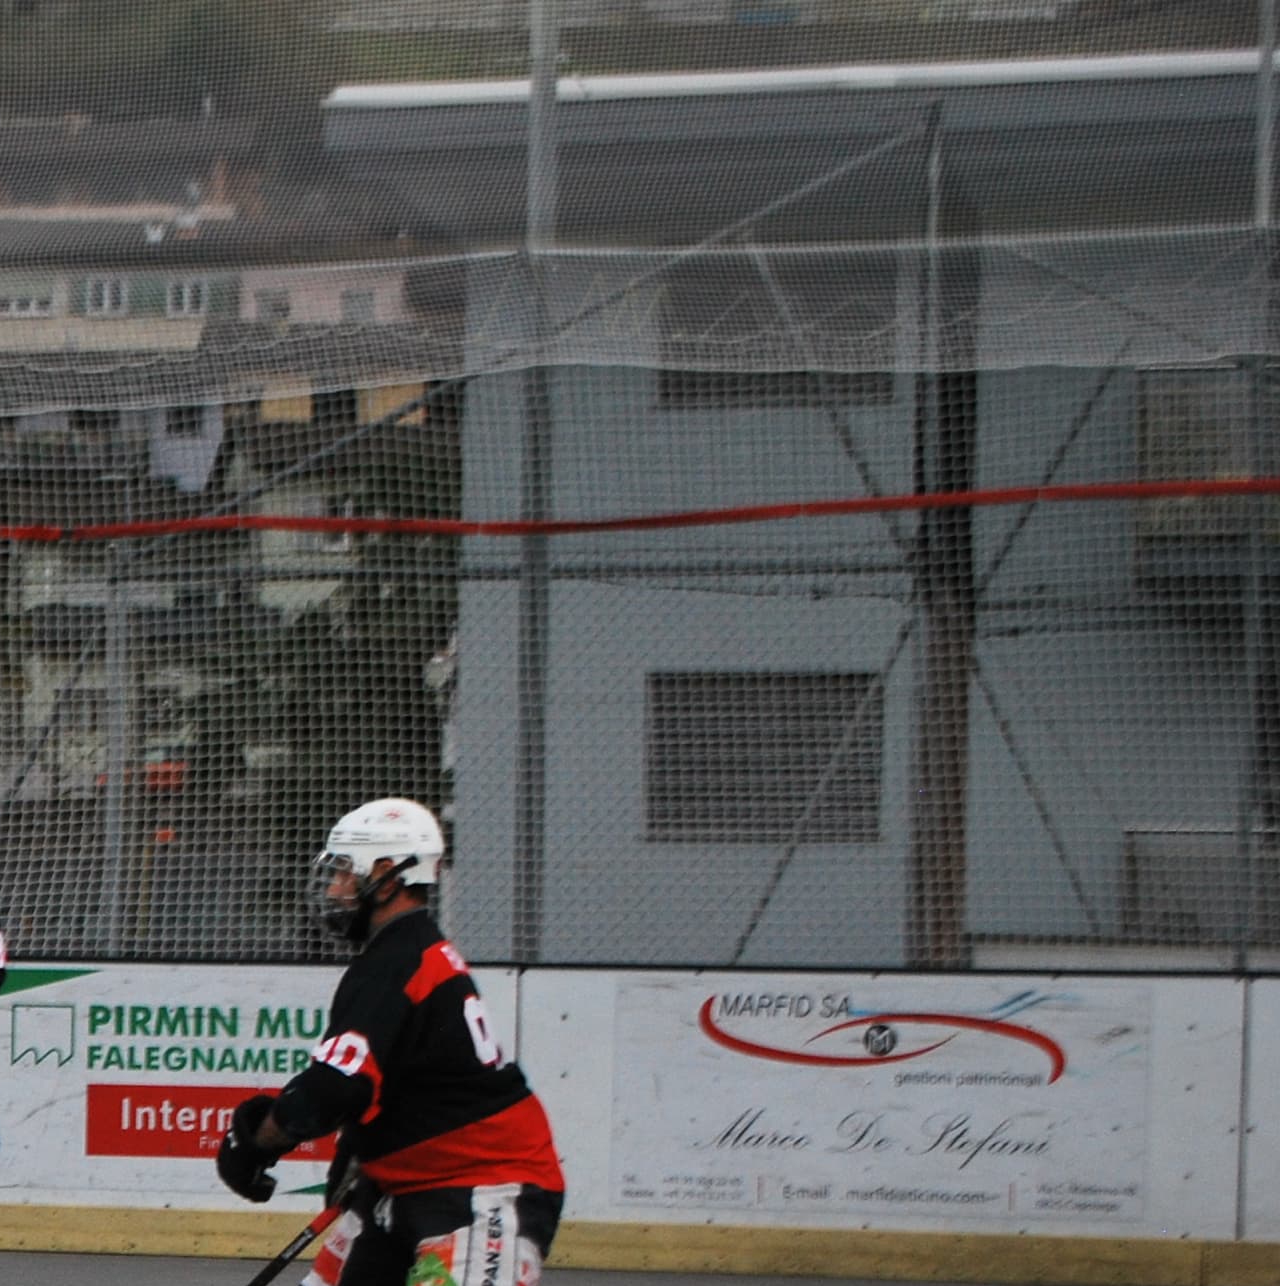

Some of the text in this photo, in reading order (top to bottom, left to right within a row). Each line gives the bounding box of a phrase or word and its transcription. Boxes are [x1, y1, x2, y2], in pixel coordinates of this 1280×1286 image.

[87, 1004, 325, 1039] PIRMIN MU
[719, 994, 849, 1019] MARFID SA
[86, 1045, 311, 1075] FALEGNAMER
[120, 1097, 236, 1133] Intern
[697, 1106, 811, 1152] Marco
[905, 1109, 1056, 1170] Stefani
[782, 1184, 830, 1200] E-mail
